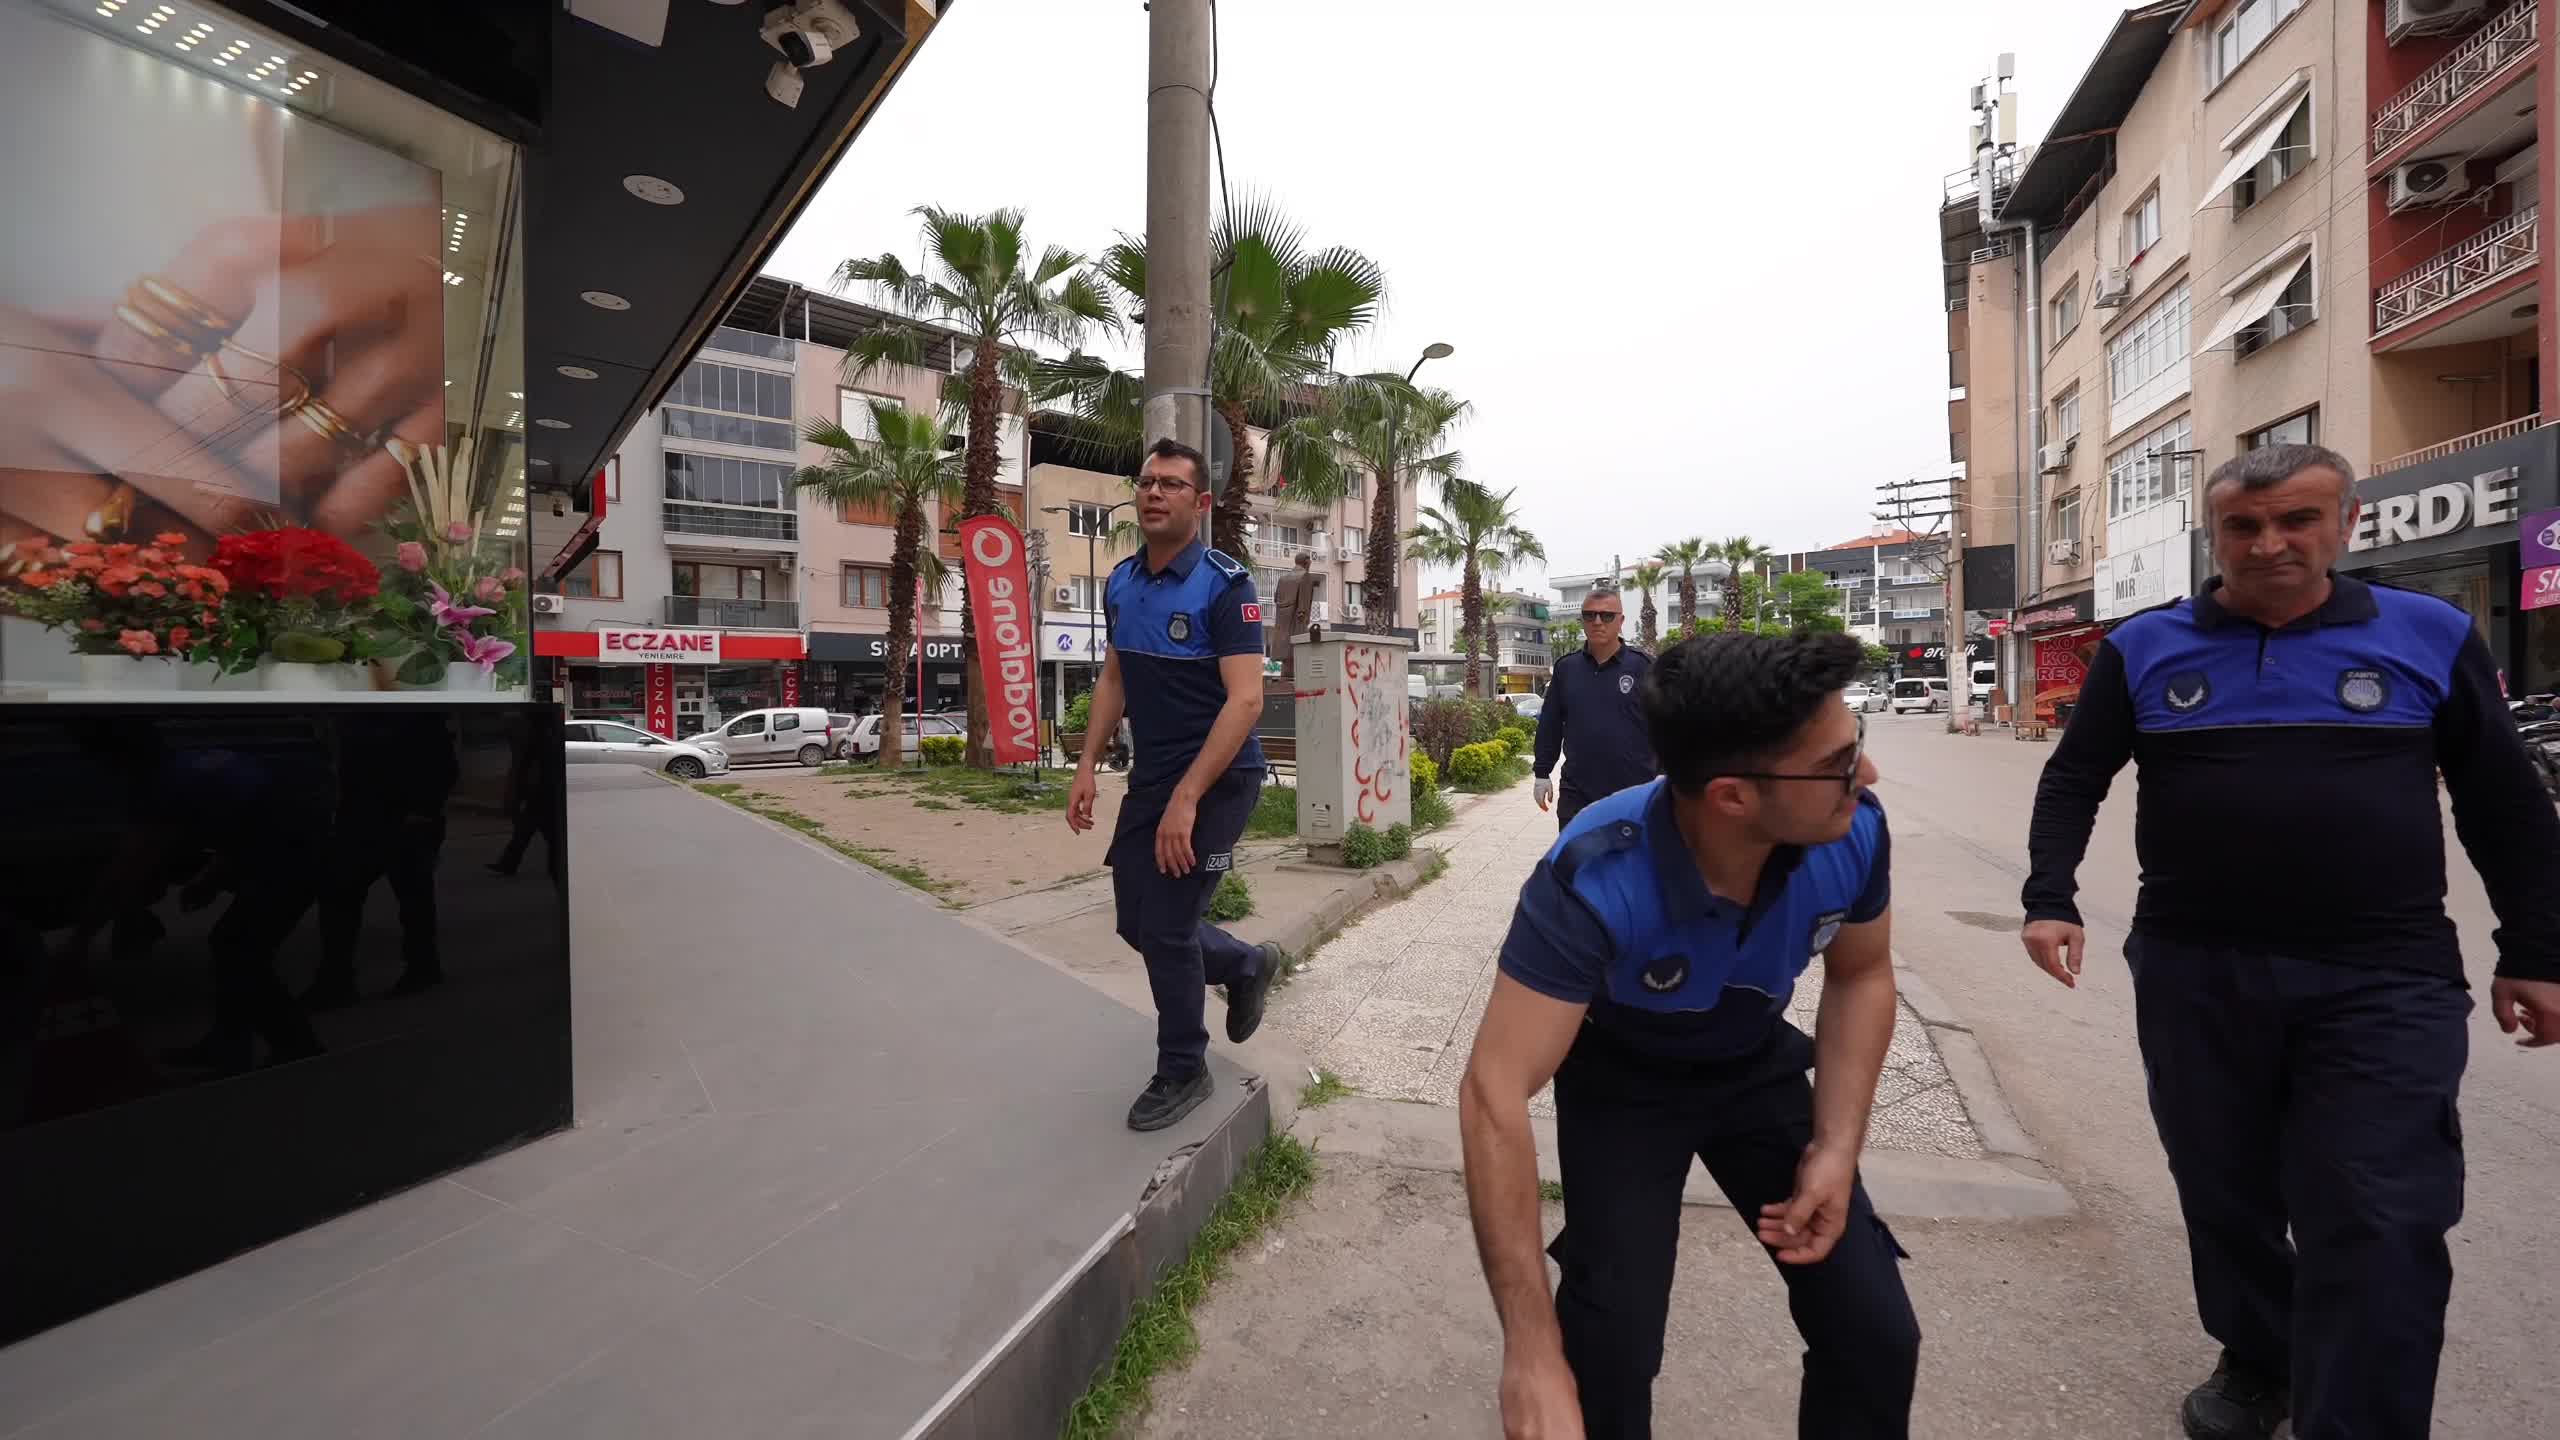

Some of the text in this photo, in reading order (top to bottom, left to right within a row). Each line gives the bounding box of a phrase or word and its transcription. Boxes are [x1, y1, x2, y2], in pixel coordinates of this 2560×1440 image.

[606, 631, 713, 651] ECZANE
[926, 642, 965, 658] OPT
[2042, 651, 2073, 666] KO
[2037, 666, 2080, 684] REÇ
[654, 663, 666, 735] ECZAN
